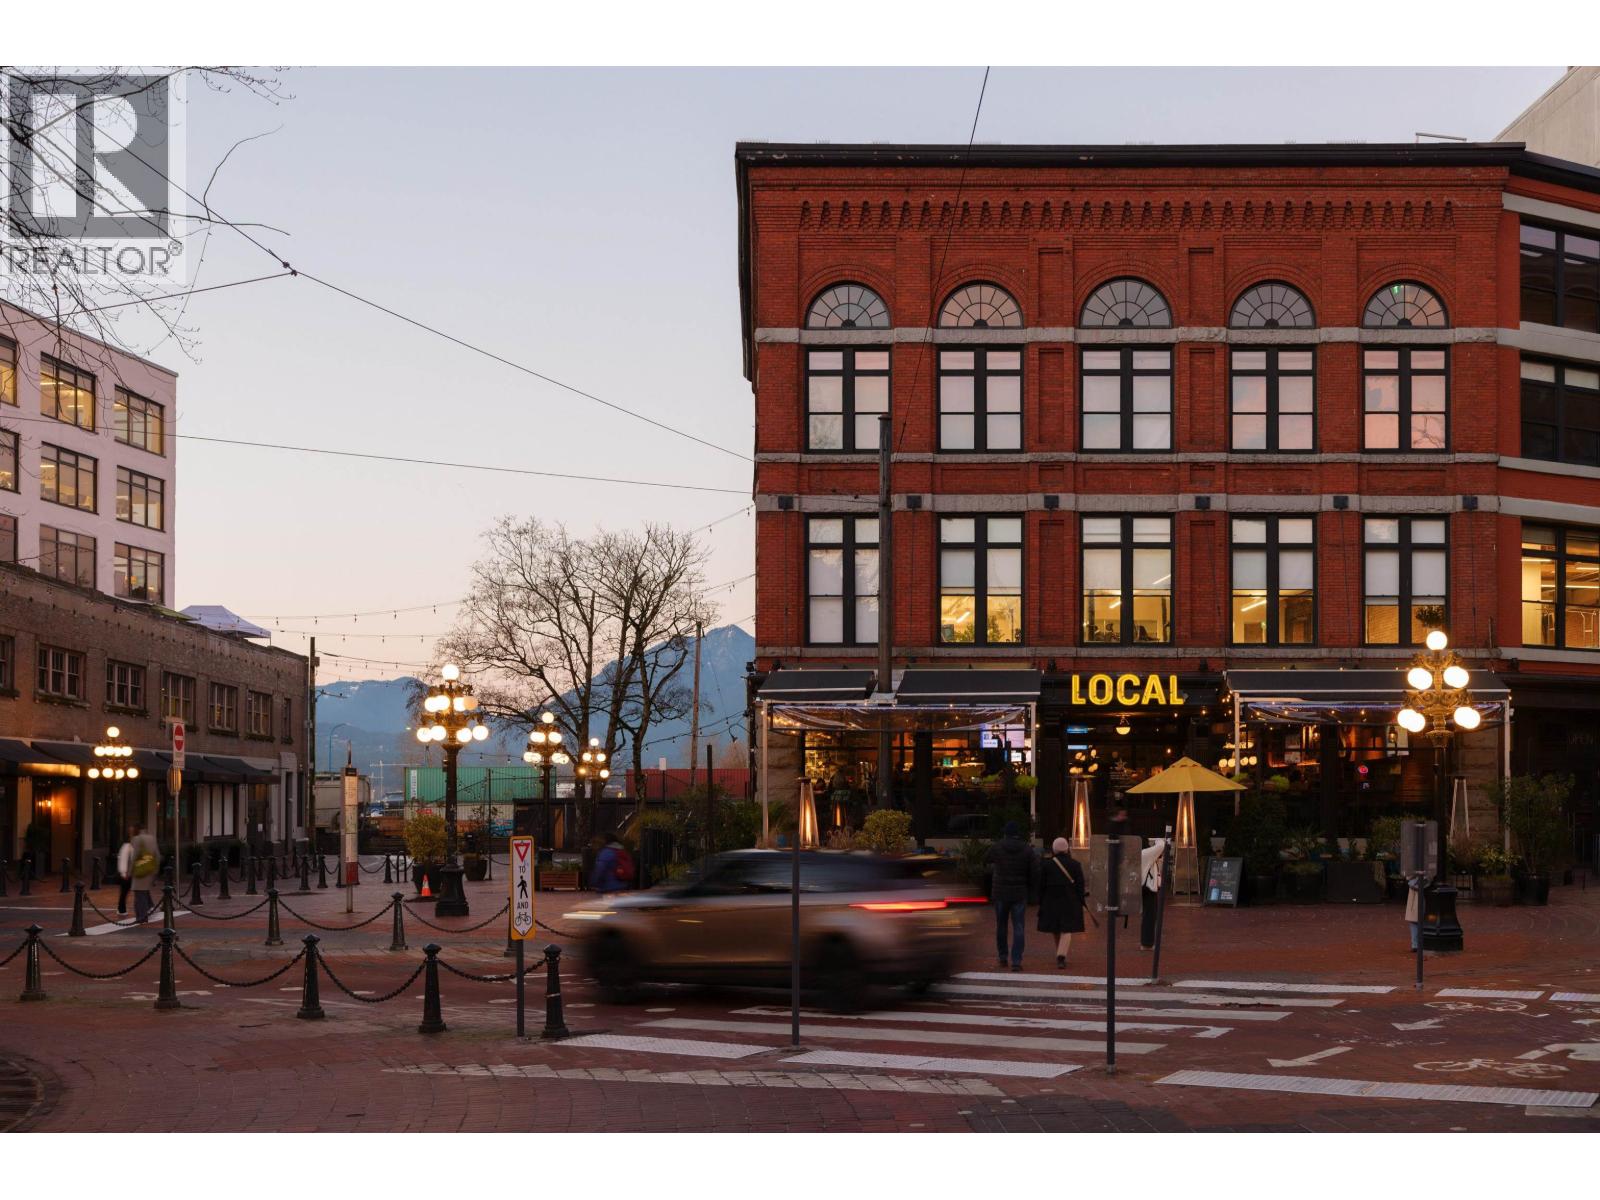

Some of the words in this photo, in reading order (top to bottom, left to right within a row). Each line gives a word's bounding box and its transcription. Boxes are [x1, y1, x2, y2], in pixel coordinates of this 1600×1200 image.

[1071, 673, 1185, 705] LOCAL
[519, 865, 526, 874] TO
[517, 901, 529, 910] AND
